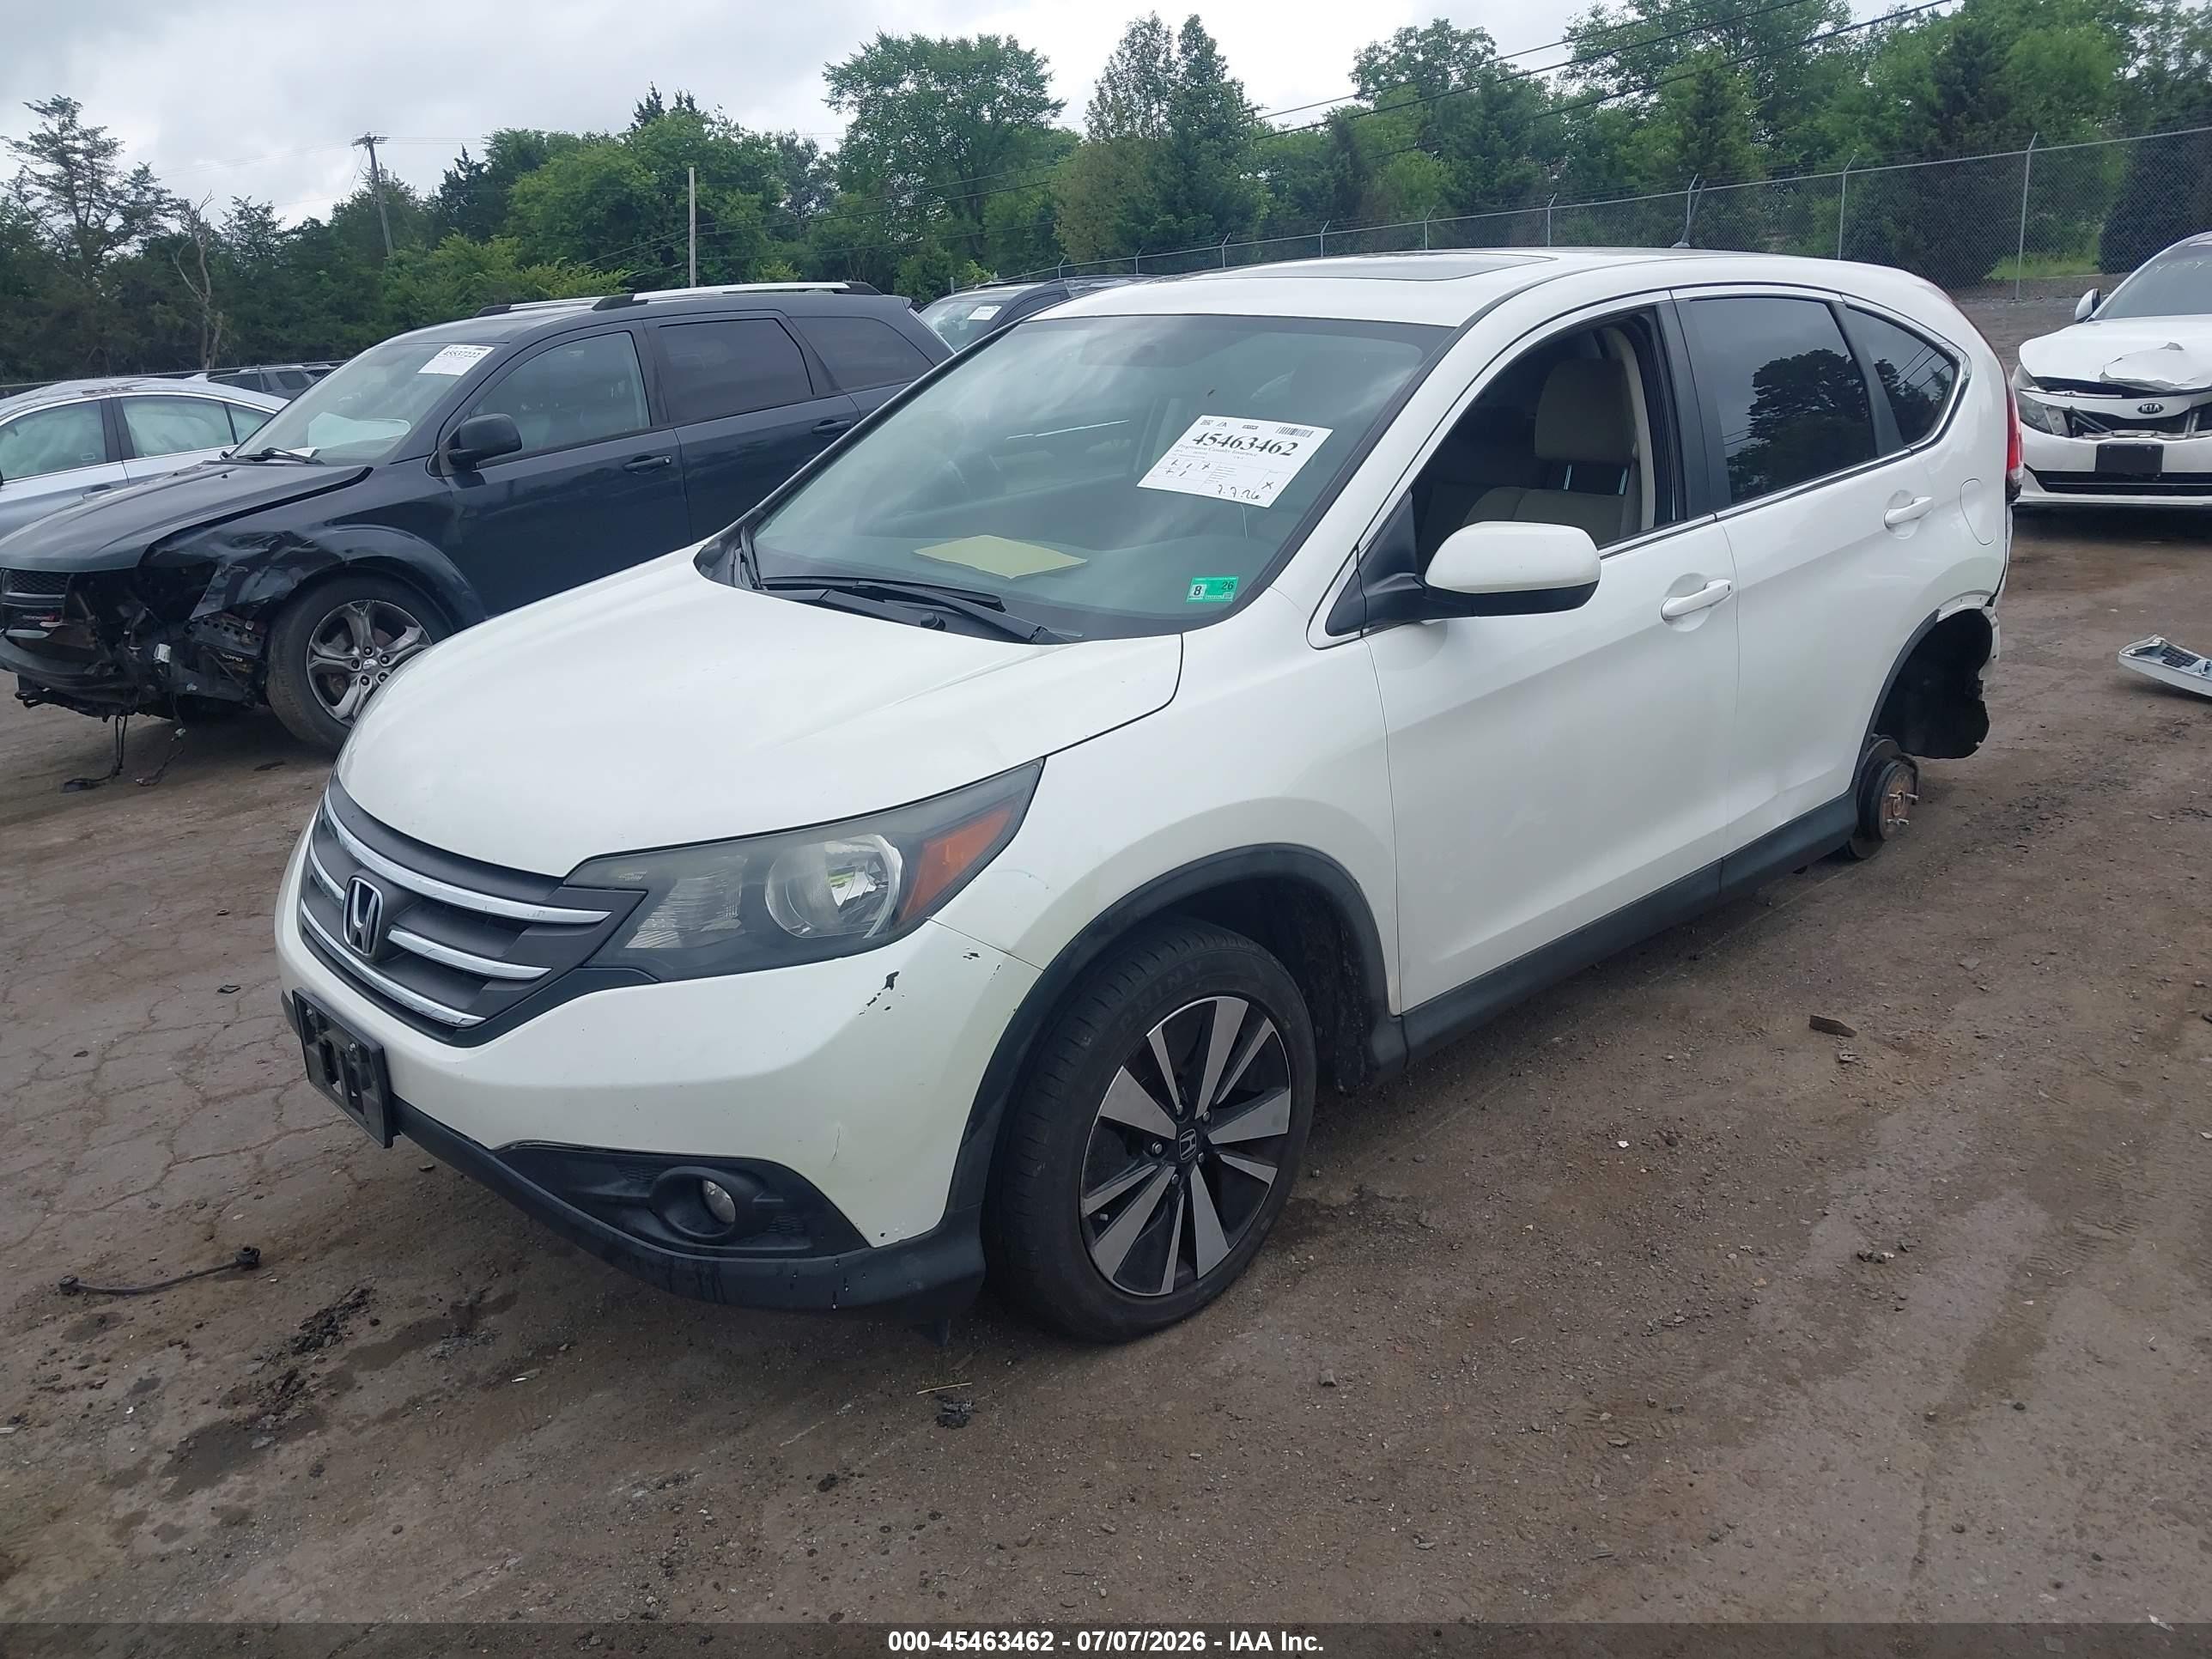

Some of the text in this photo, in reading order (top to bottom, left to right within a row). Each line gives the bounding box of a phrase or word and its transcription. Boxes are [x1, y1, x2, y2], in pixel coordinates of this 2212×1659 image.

[2142, 404, 2160, 413] KIA
[1177, 443, 1208, 452] Progressive
[1192, 431, 1298, 457] 45463462
[1221, 580, 1234, 590] 26
[1194, 585, 1202, 596] 8
